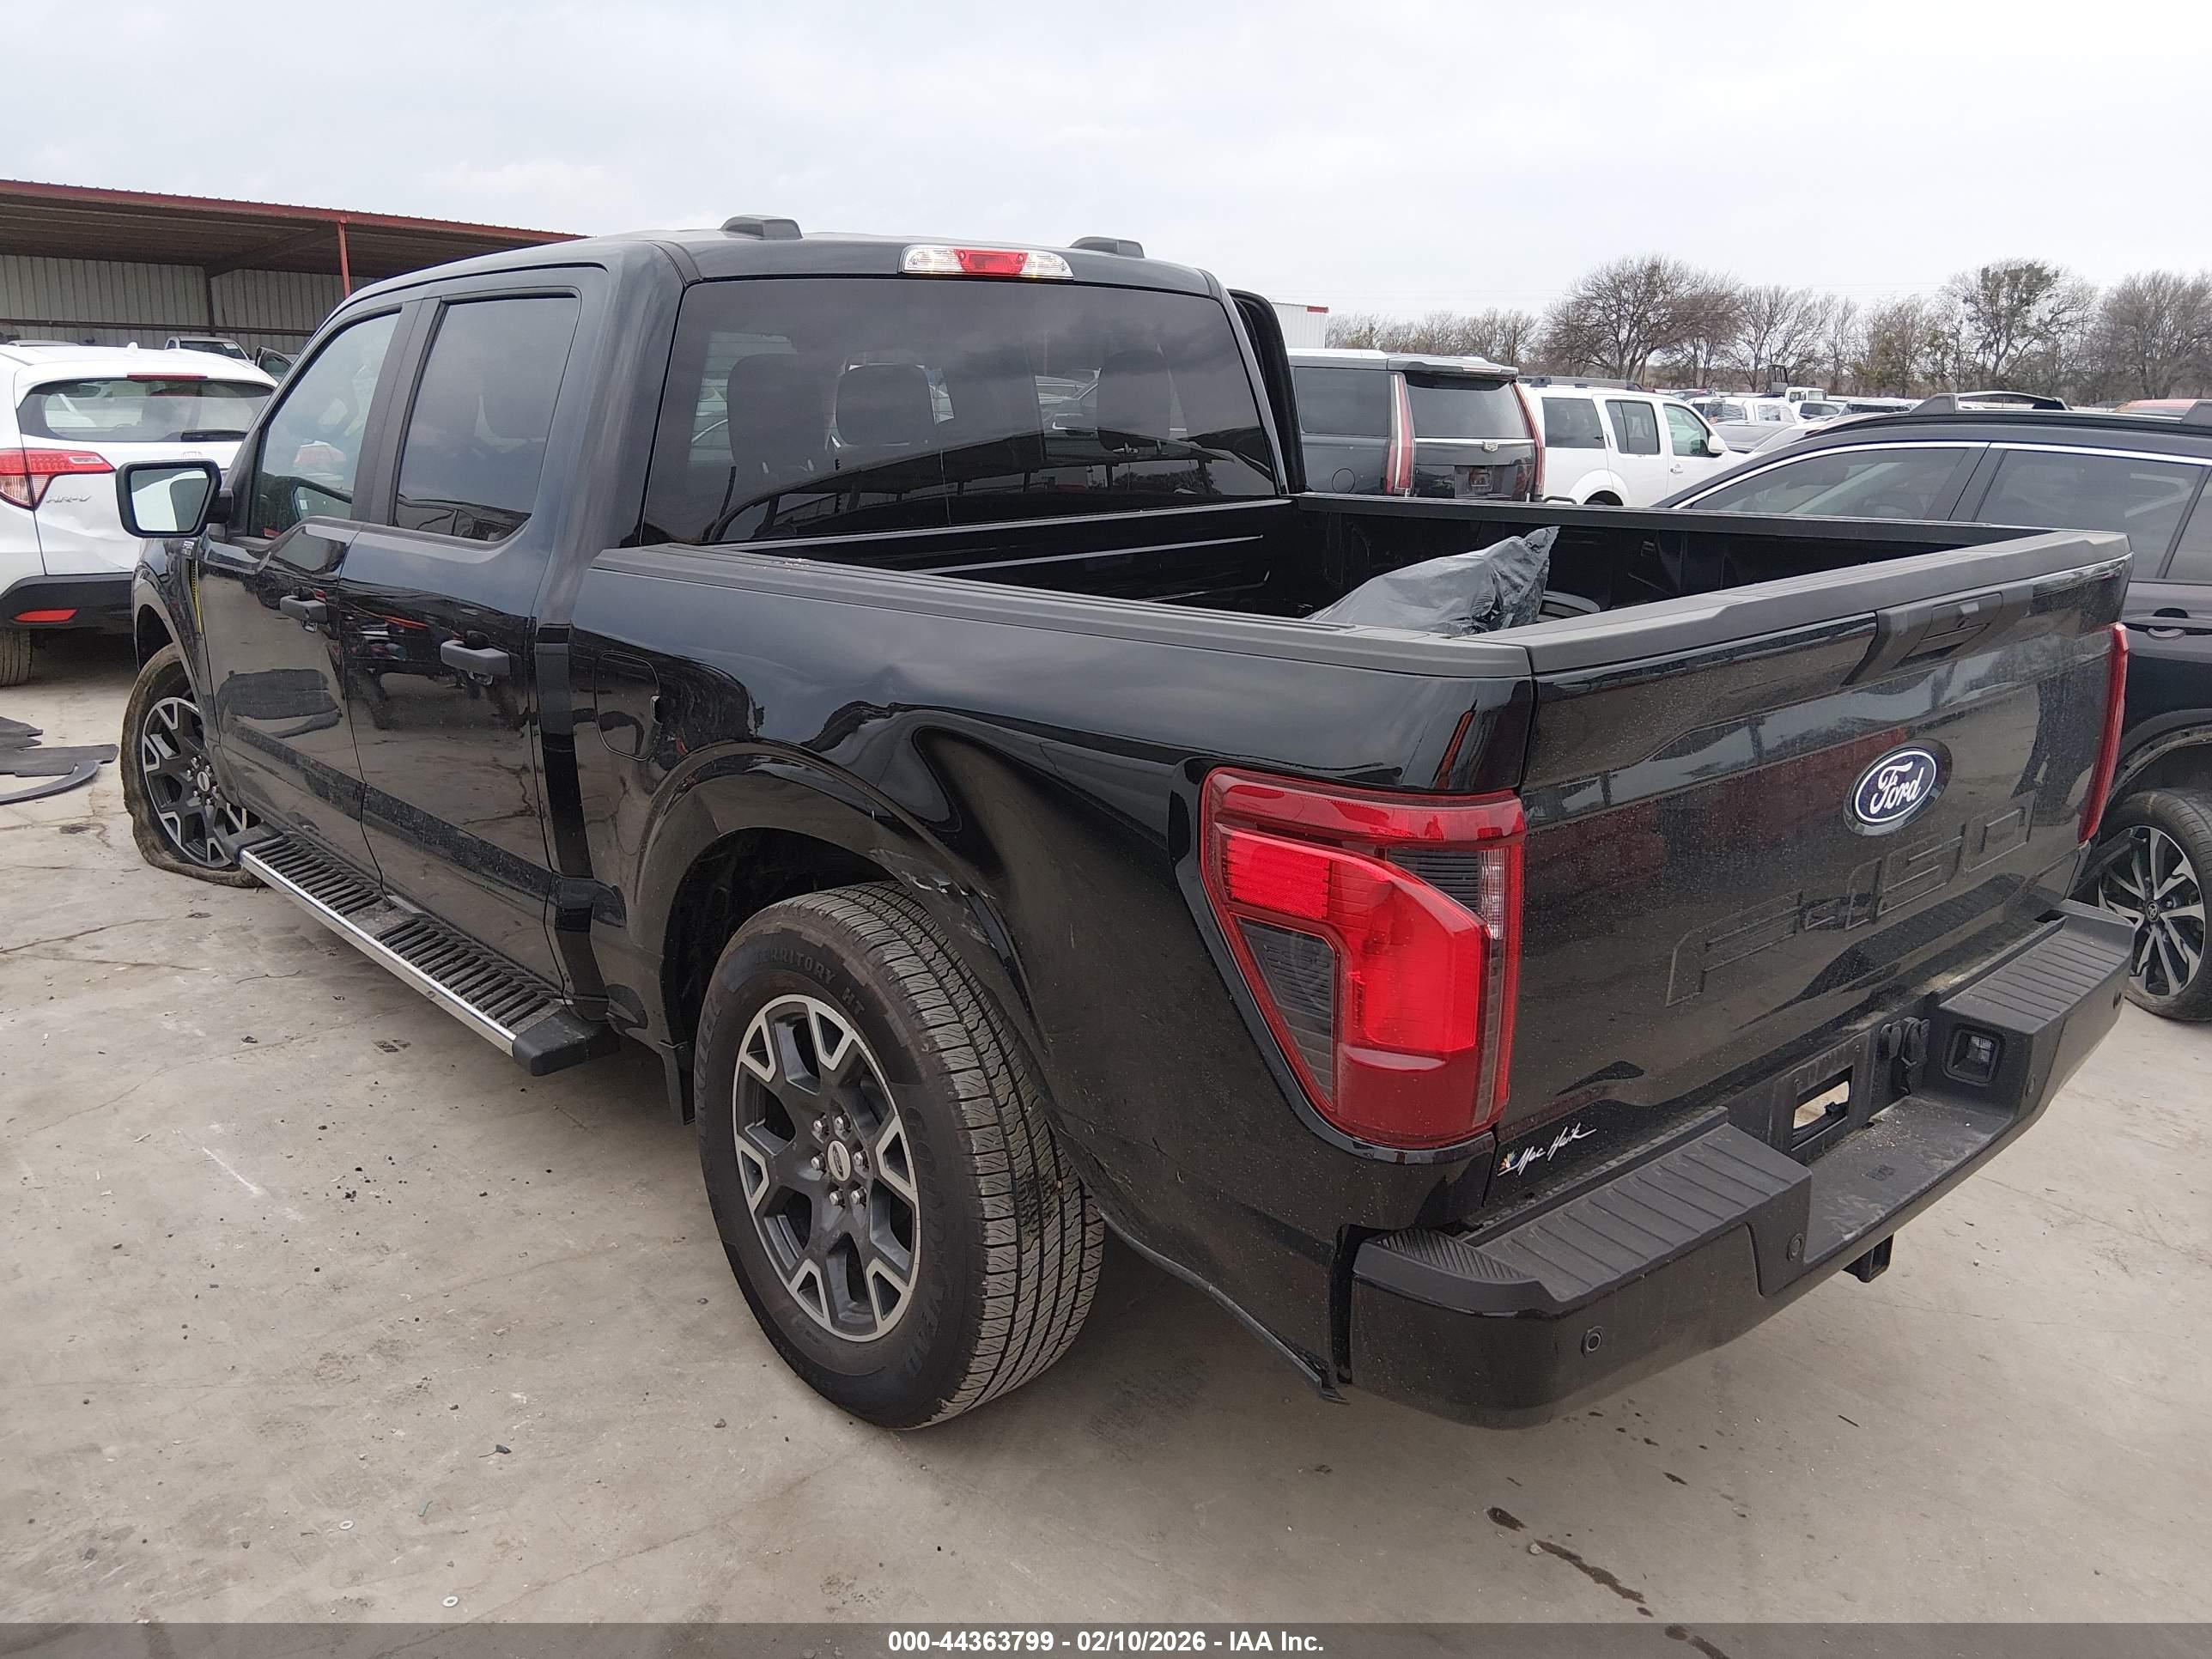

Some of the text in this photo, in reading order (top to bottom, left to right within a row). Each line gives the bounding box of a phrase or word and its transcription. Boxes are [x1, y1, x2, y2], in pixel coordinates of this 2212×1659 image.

[1869, 761, 1924, 815] Ford
[1665, 791, 2037, 1007] F-150
[755, 948, 836, 984] TERRITORY
